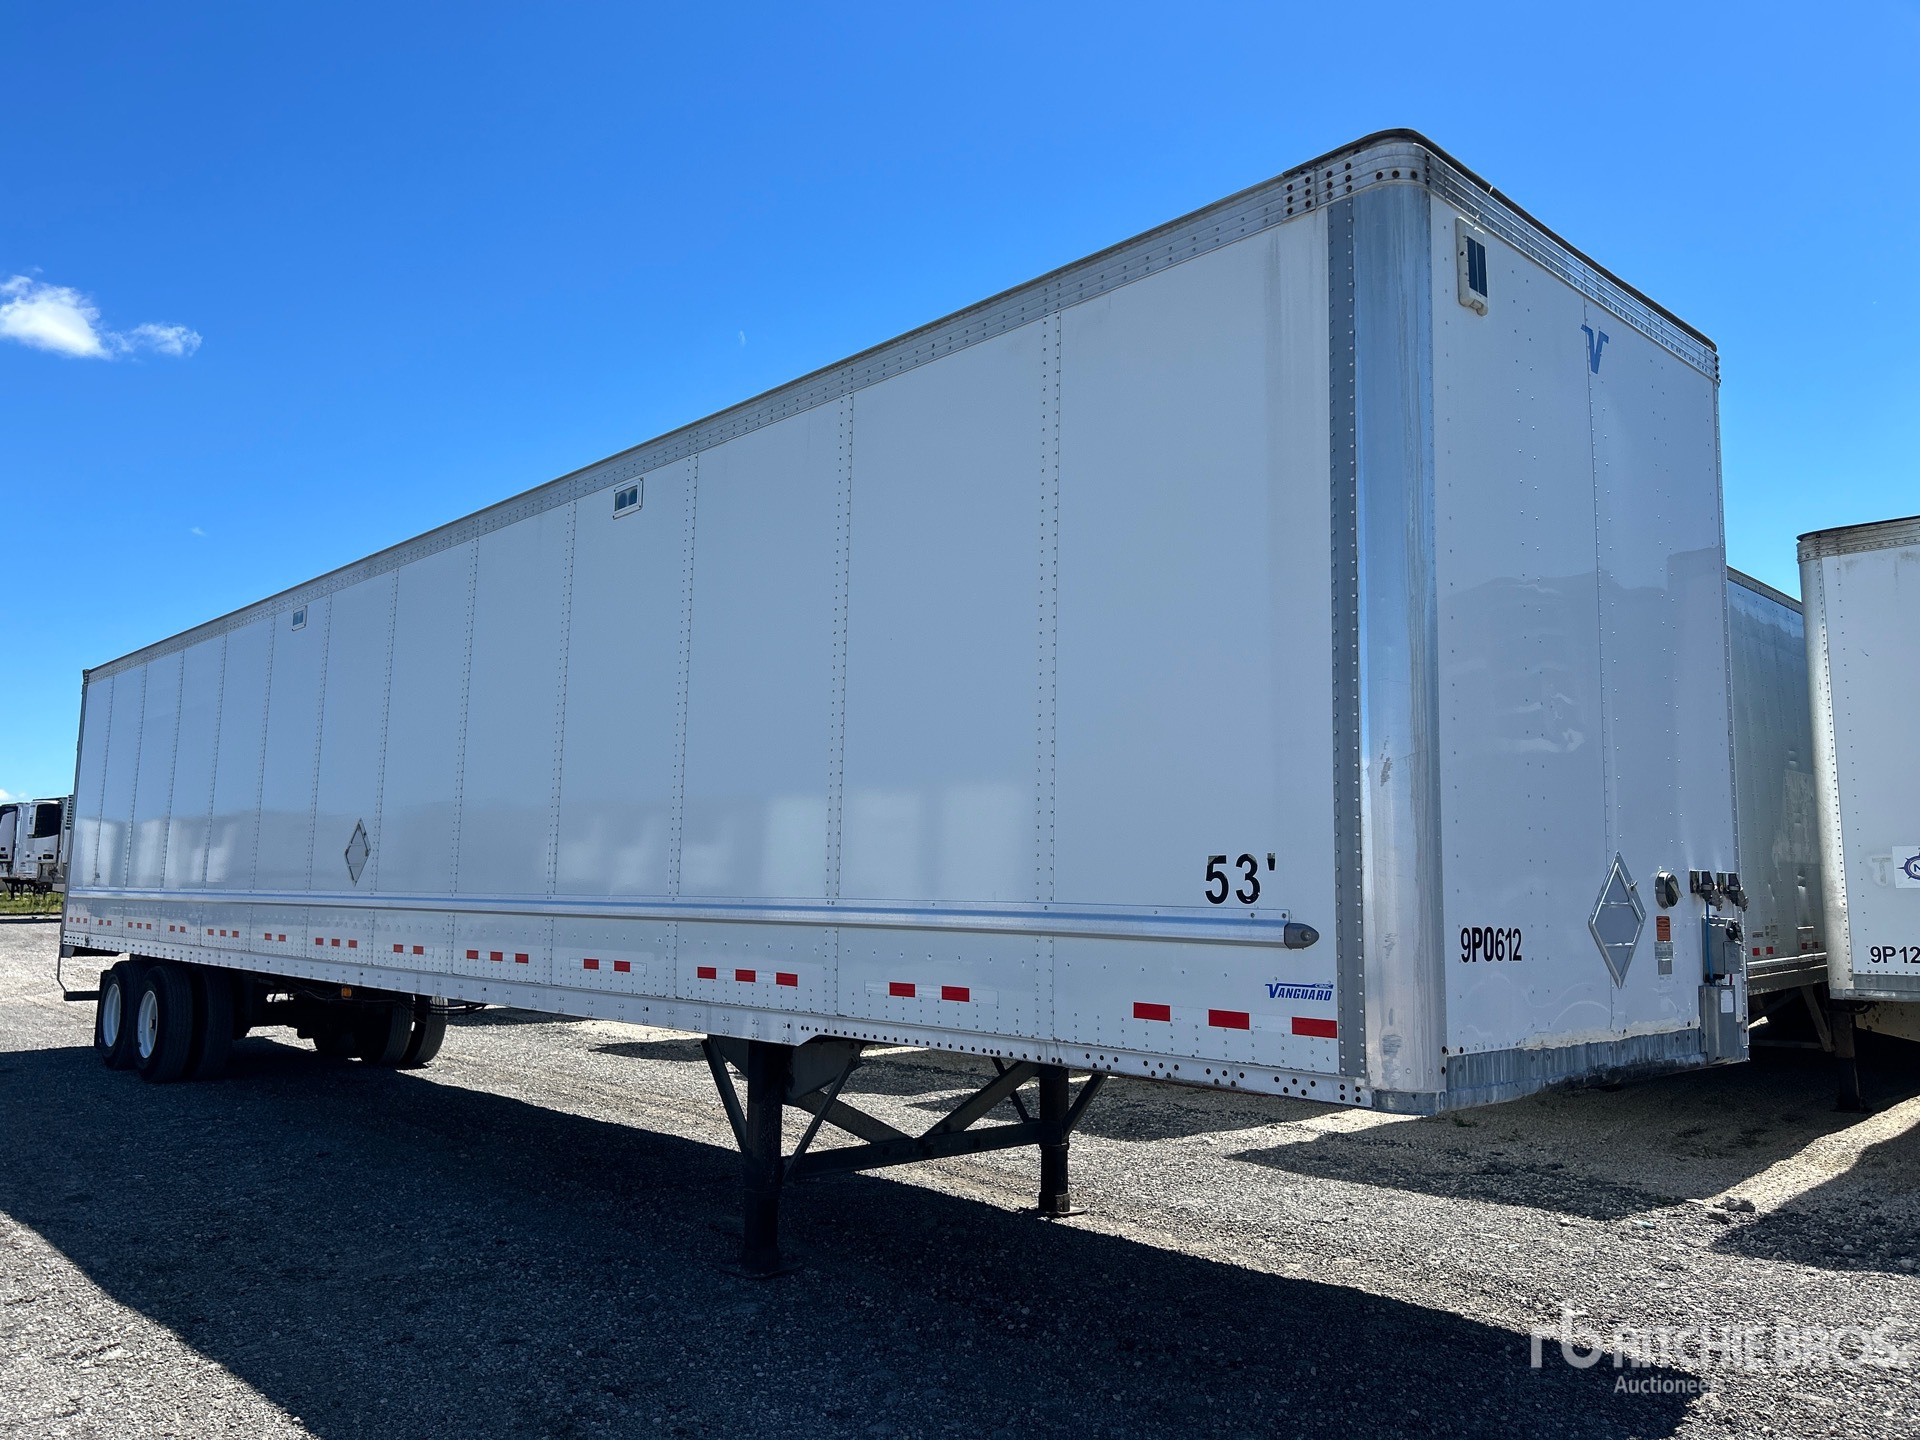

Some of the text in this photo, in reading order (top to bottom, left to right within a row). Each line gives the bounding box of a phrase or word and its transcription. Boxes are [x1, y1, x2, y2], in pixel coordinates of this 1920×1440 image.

[1460, 926, 1523, 963] 9P0612
[1870, 946, 1920, 963] 9P12
[1265, 983, 1332, 1001] VANGUARD
